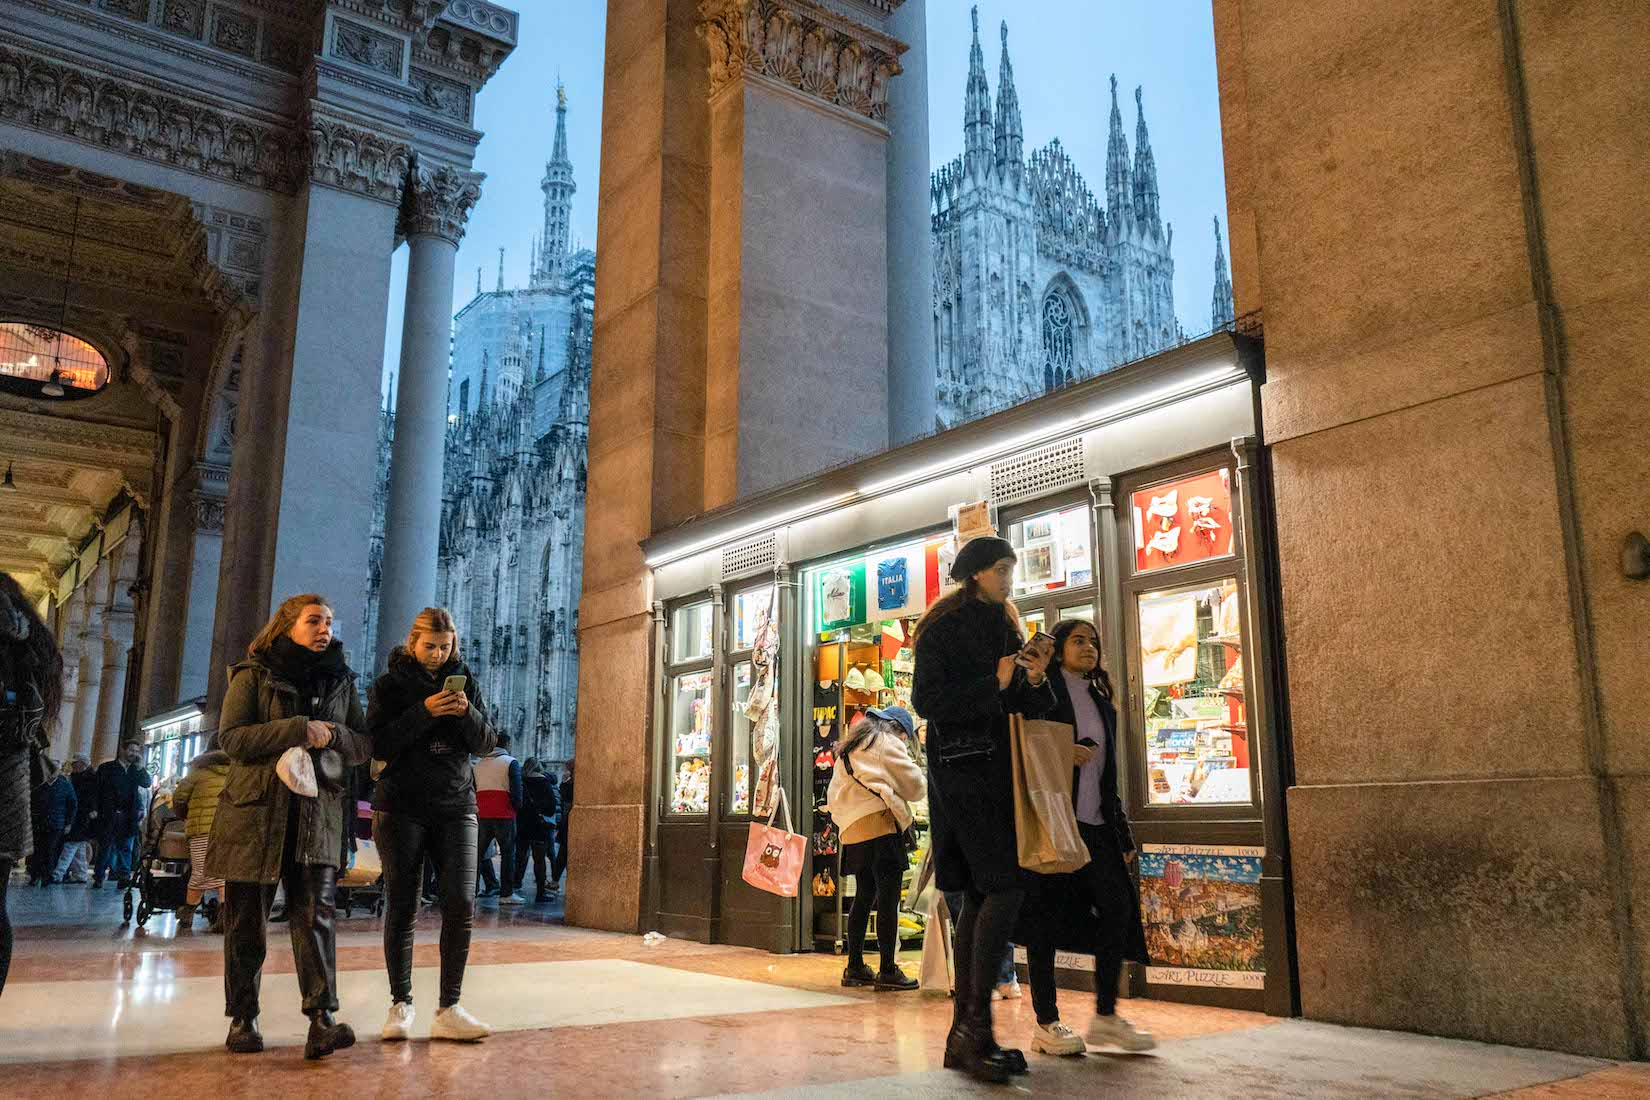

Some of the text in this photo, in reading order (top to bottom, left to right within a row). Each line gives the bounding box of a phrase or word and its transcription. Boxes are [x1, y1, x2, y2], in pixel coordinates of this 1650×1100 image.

[882, 574, 903, 585] ITALIA
[945, 577, 955, 586] MIL
[813, 706, 837, 721] TUPAC
